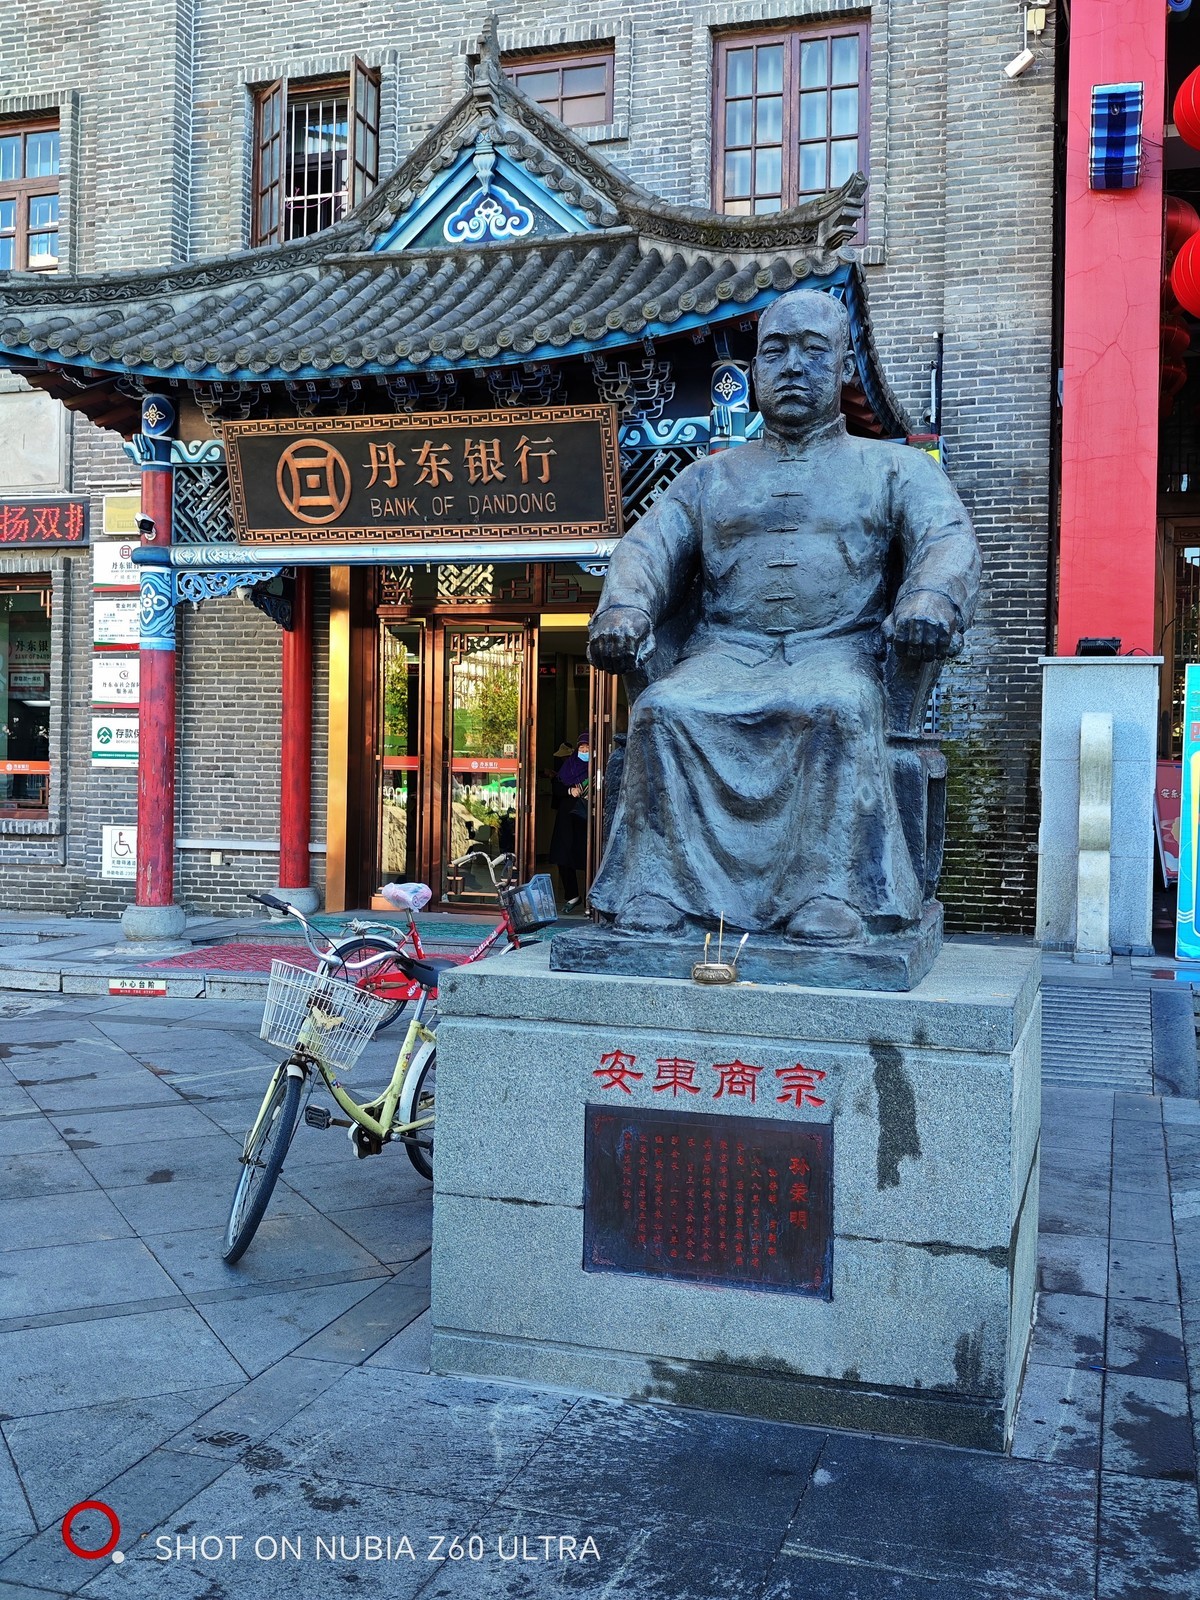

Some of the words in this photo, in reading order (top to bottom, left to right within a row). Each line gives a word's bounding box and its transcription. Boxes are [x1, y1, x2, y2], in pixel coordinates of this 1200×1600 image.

[361, 434, 557, 489] 丹东银行
[370, 497, 420, 518] BANK
[432, 496, 455, 516] OF
[468, 492, 557, 515] DANDONG
[119, 980, 155, 989] 小心台阶
[592, 1049, 827, 1109] 安東商宗
[788, 1157, 811, 1232] 孙荣明
